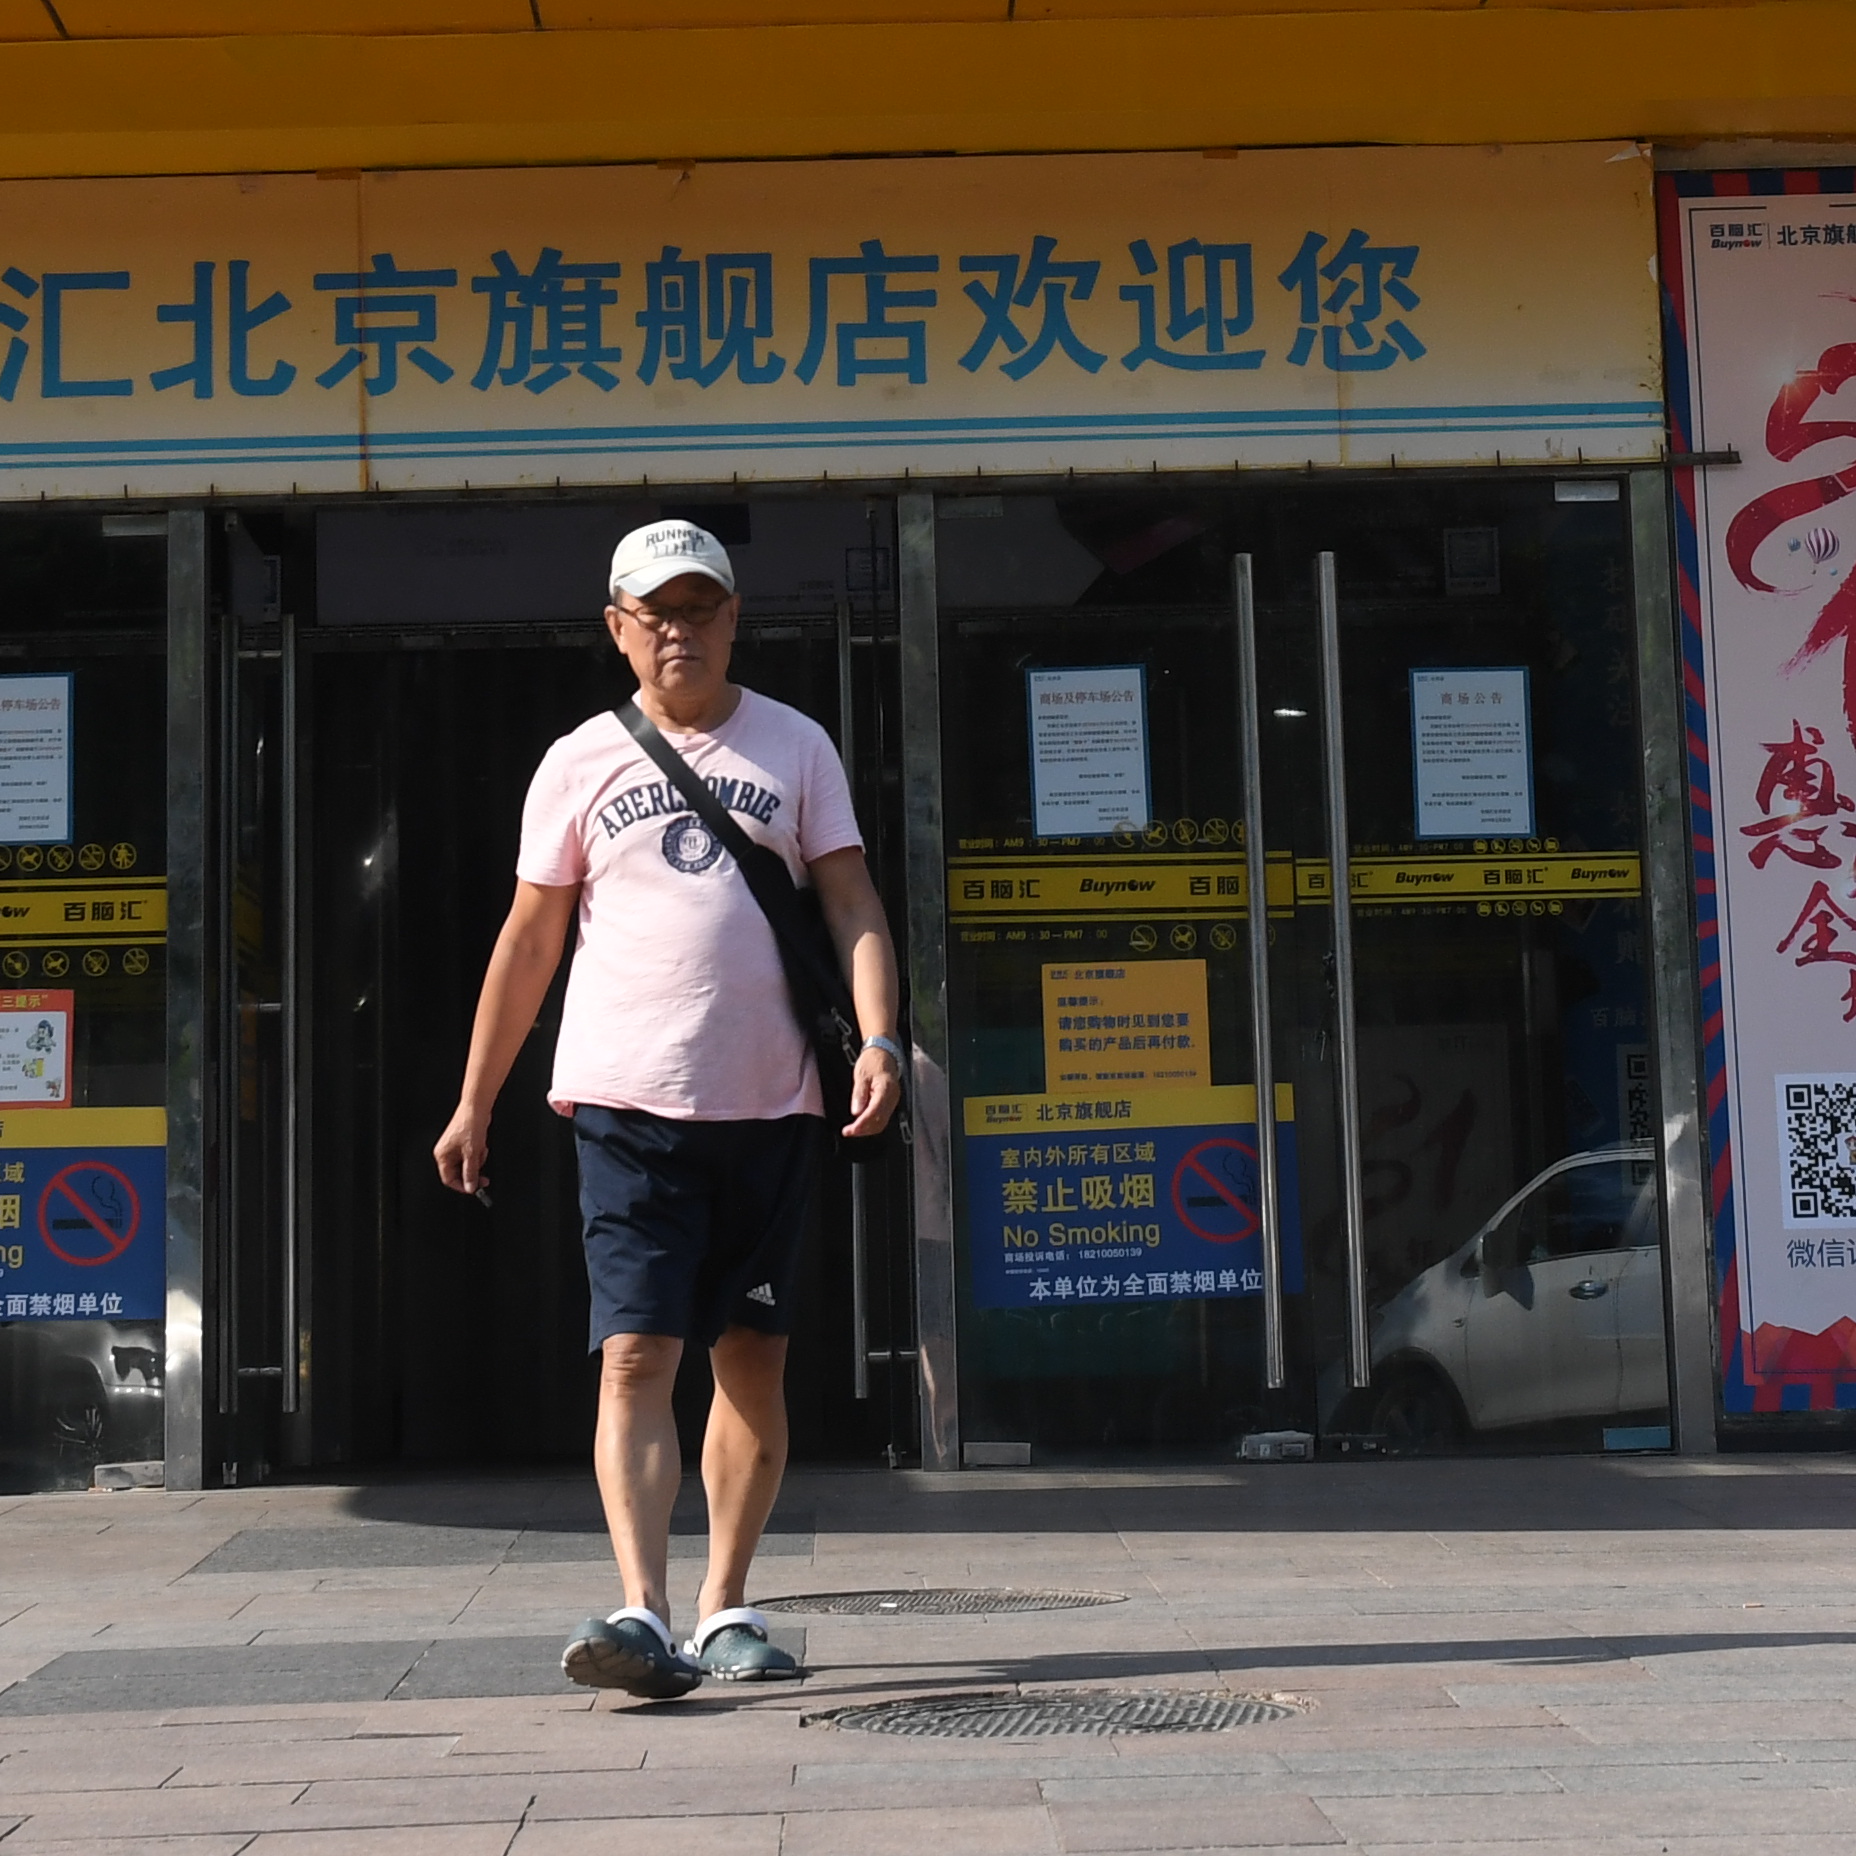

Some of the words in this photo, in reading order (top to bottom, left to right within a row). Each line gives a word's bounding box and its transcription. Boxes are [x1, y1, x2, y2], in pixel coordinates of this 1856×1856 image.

[1710, 223, 1763, 237] 百脑汇
[1710, 238, 1762, 250] Buynow
[1040, 690, 1134, 706] 商场及停车场公告
[1441, 691, 1503, 705] 商场公告
[1396, 871, 1455, 885] Buynow
[1484, 868, 1544, 886] 百脑汇
[1571, 867, 1630, 882] Buynow
[963, 879, 1040, 899] 百脑汇
[1079, 879, 1156, 896] Buynow
[64, 901, 143, 922] 百脑汇
[1074, 967, 1126, 980] 北京旗舰店
[1058, 1012, 1189, 1031] 请您购物时见到您要
[985, 1104, 1022, 1115] 百脑汇
[1036, 1100, 1132, 1121] 北京旗舰店
[1000, 1141, 1156, 1169] 室内外所有区域
[1002, 1173, 1156, 1215] 禁止吸烟
[1003, 1224, 1039, 1248] No
[1049, 1220, 1160, 1247] Smoking
[1078, 1247, 1142, 1259] 18210050139
[1030, 1268, 1263, 1301] 本单位为全面禁烟单位
